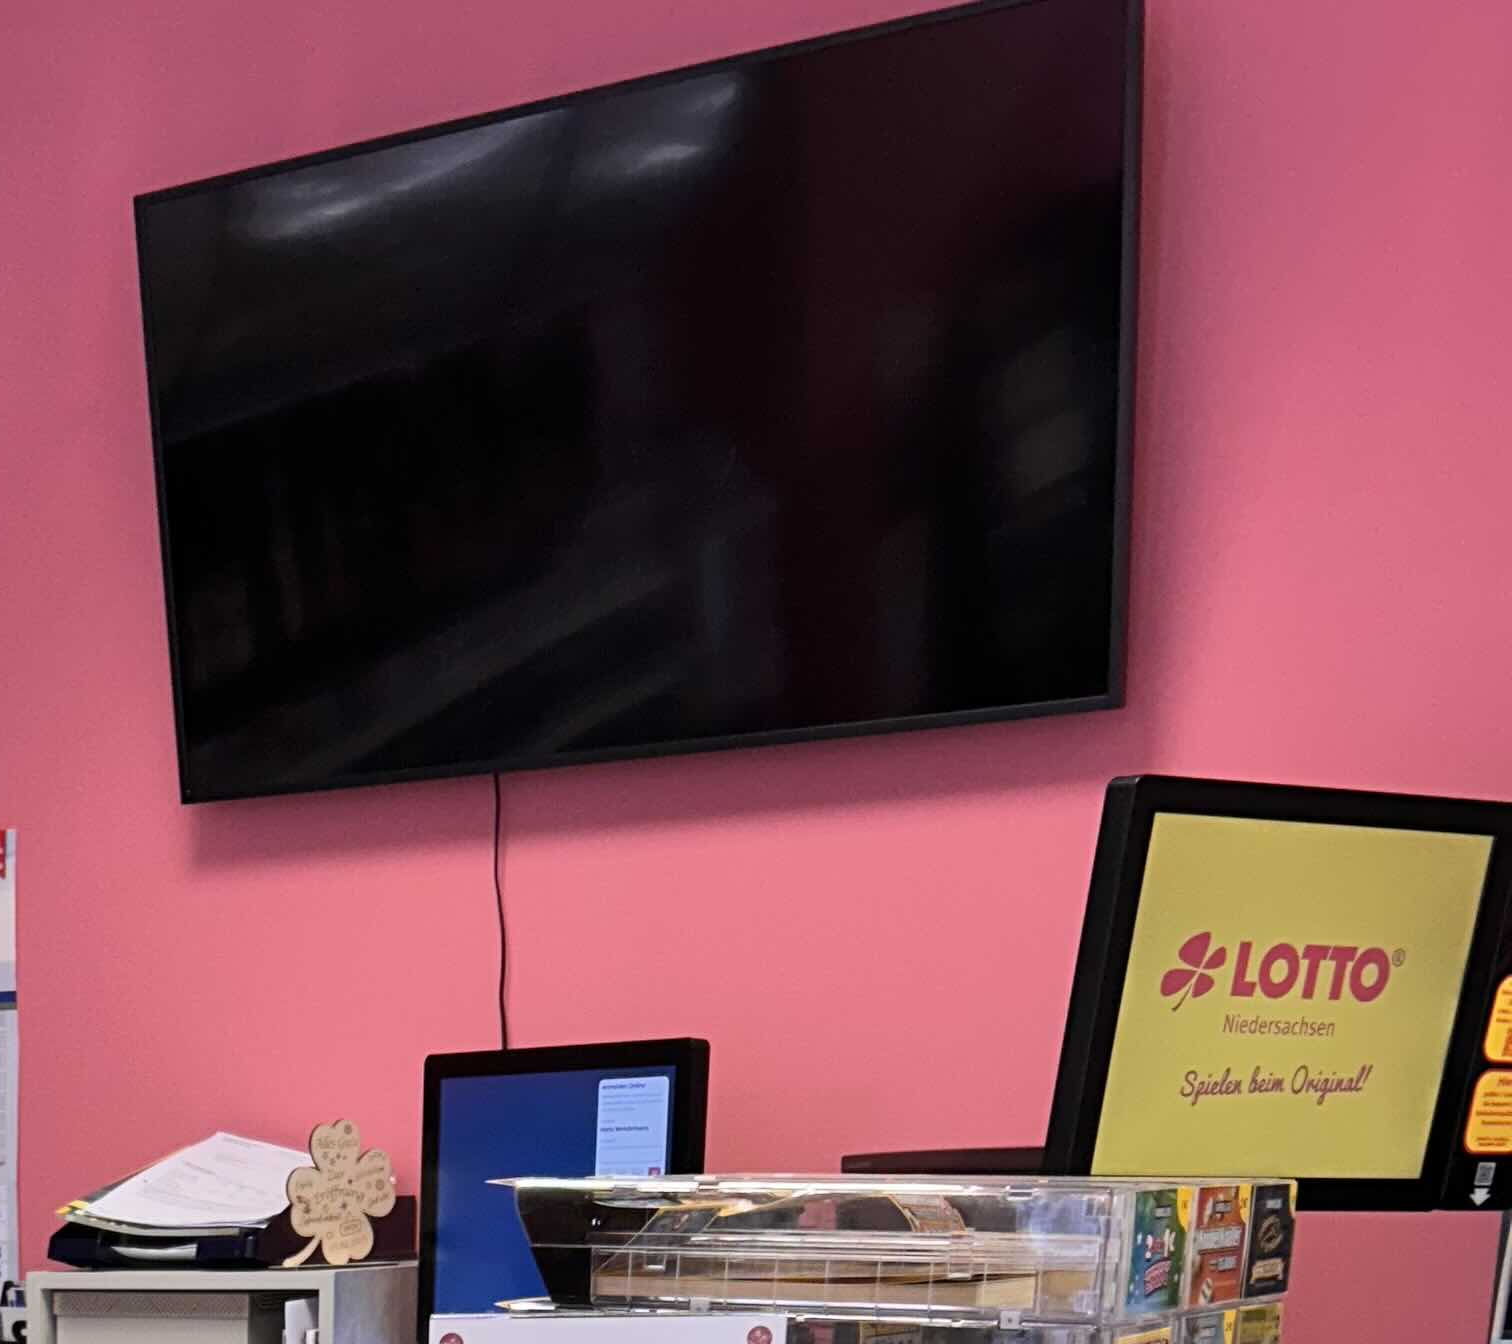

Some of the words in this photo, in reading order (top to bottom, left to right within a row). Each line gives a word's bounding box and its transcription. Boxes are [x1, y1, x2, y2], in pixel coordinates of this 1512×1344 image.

[1229, 941, 1391, 1002] LOTTO
[1223, 1014, 1335, 1037] Niedersachsen
[1180, 1070, 1242, 1107] Spielen
[1248, 1066, 1285, 1094] beim
[1290, 1064, 1373, 1105] Original!
